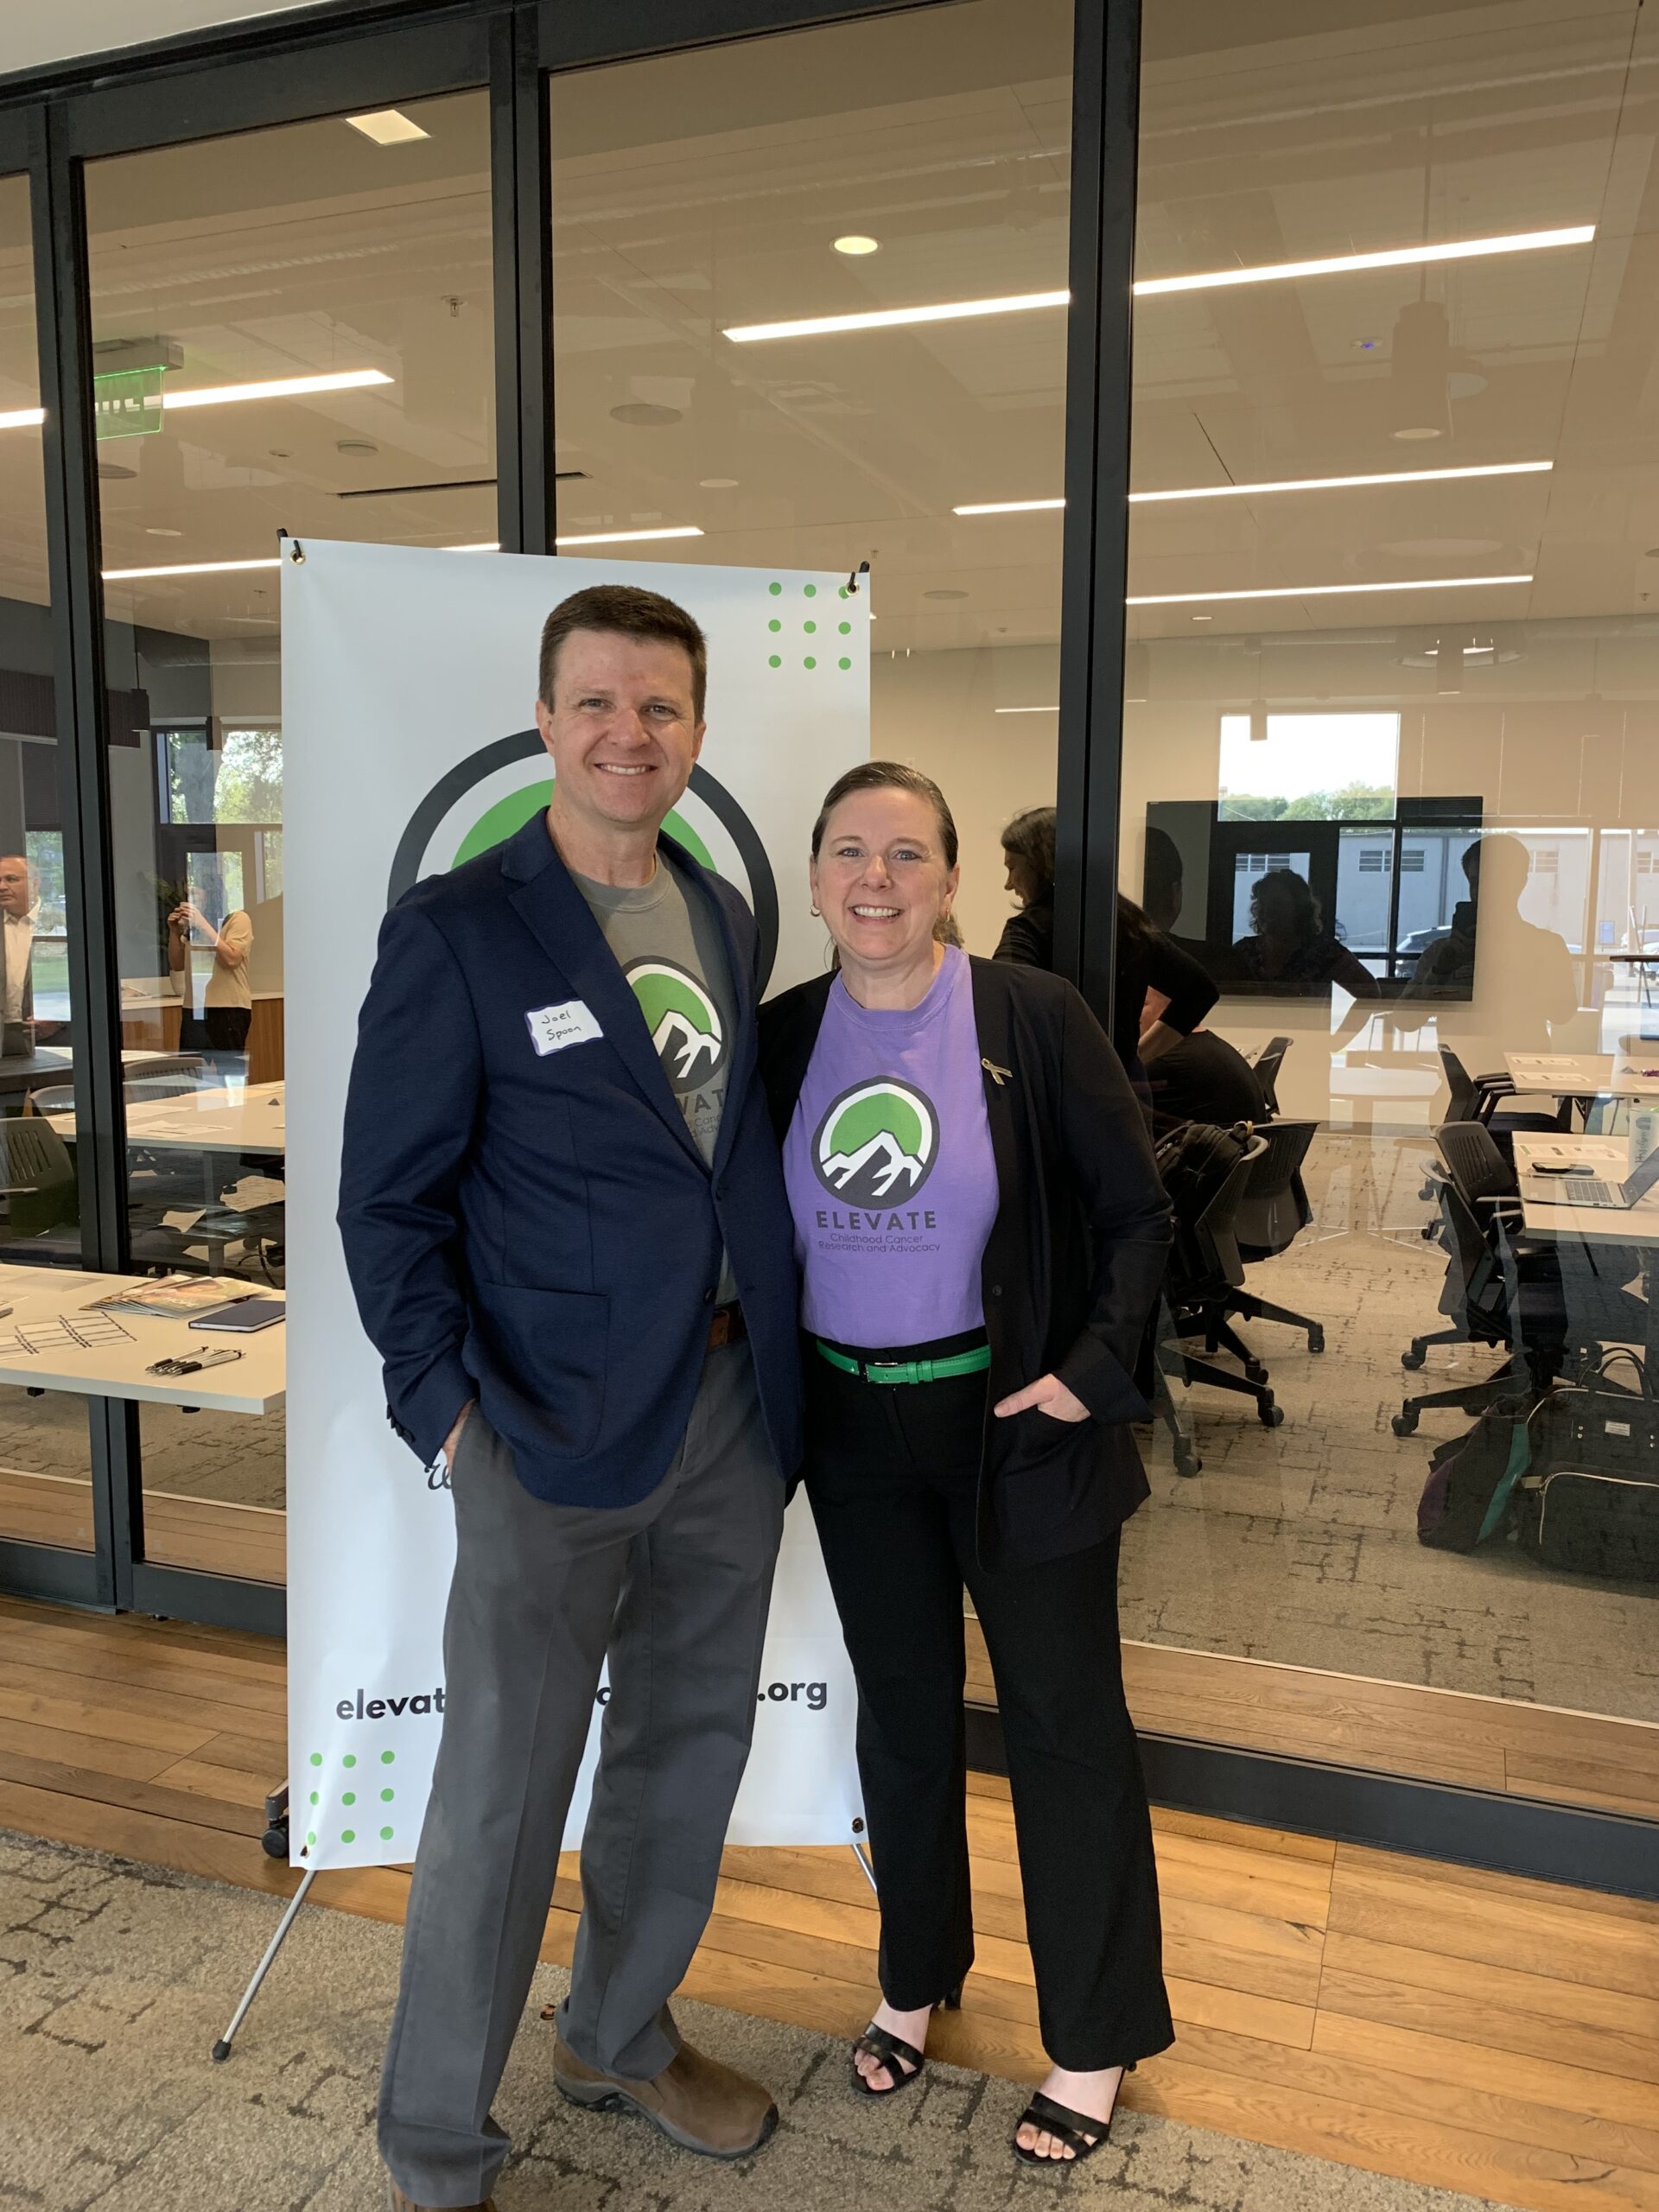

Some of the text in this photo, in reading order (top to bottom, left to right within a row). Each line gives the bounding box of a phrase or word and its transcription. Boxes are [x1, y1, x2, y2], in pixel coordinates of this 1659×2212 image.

[541, 1009, 571, 1024] Joel
[546, 1026, 582, 1041] Spoon
[815, 1211, 938, 1230] ELEVATE
[830, 1233, 924, 1244] Childhood Cancer
[817, 1241, 941, 1253] Research and Advocacy
[757, 1681, 827, 1710] .org
